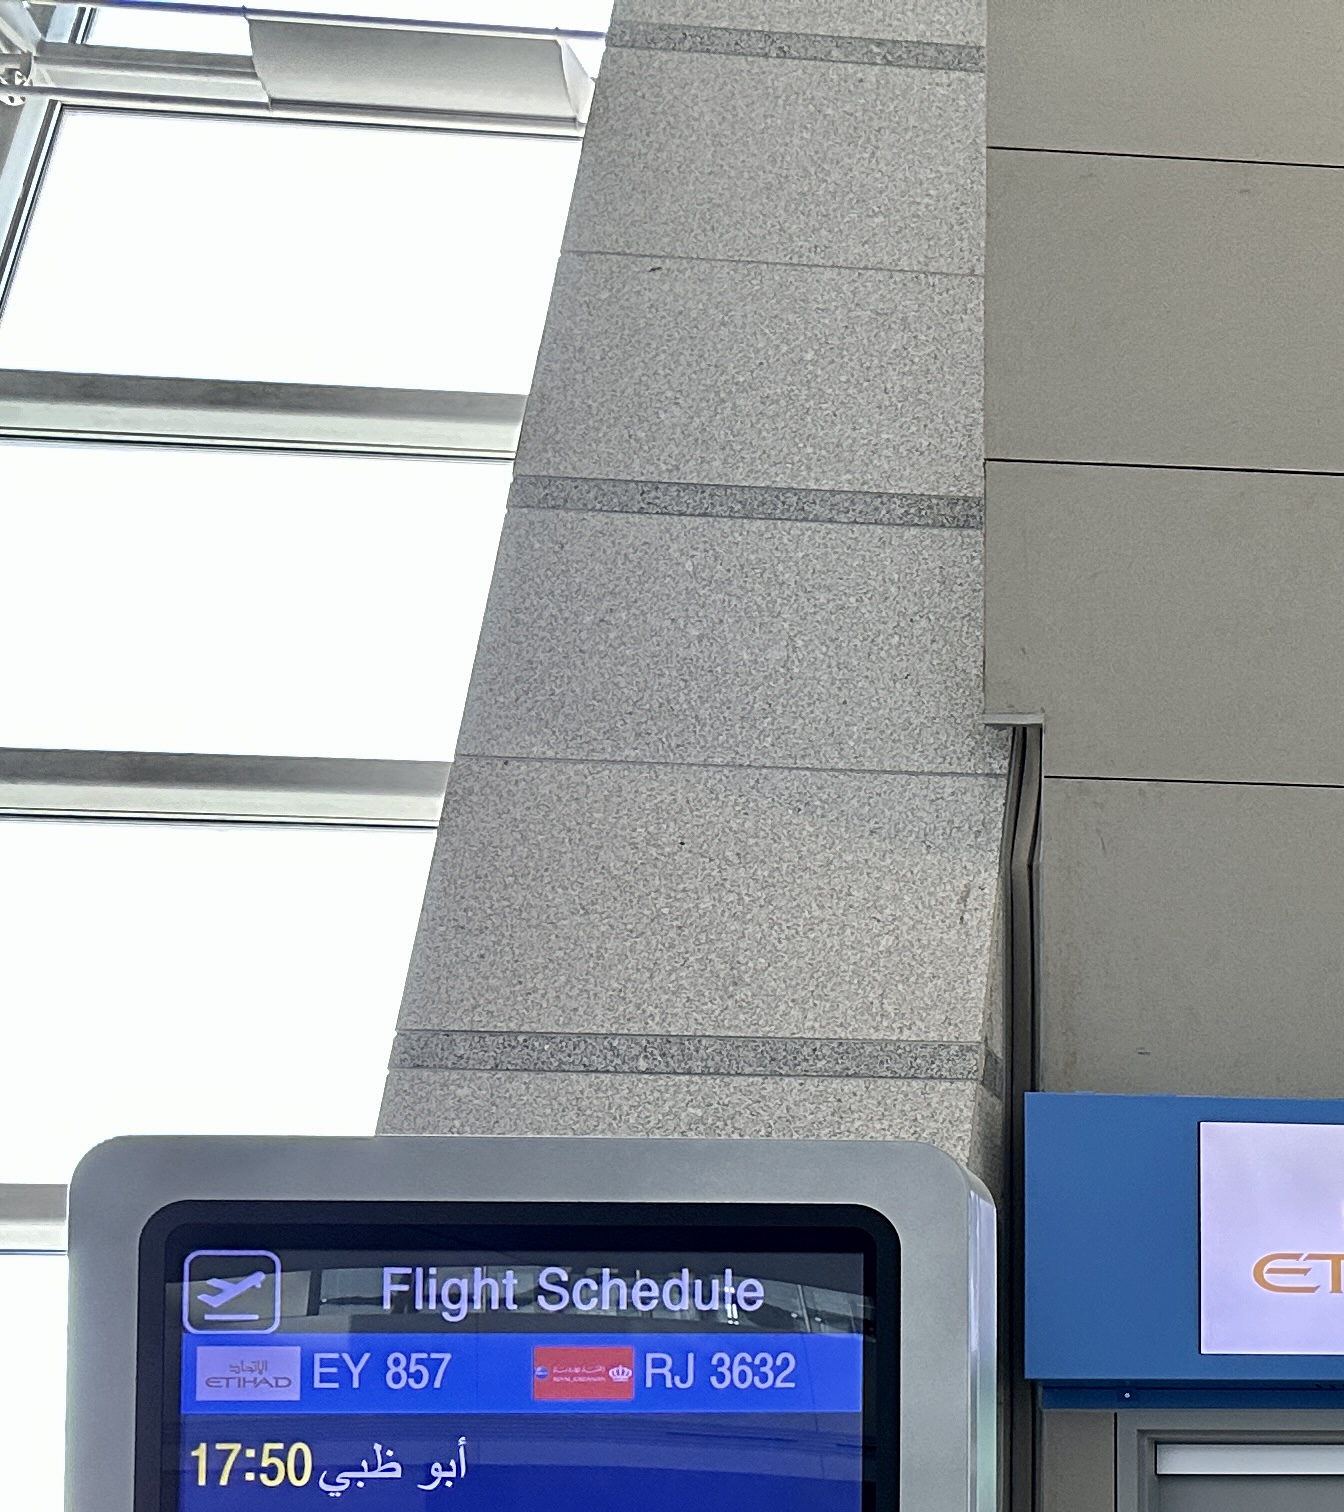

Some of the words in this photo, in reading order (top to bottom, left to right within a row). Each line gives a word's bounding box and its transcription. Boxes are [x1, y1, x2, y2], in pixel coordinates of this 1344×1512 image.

[382, 1266, 519, 1323] Flight
[537, 1266, 765, 1312] Schedule
[205, 1377, 292, 1389] ETIHAD
[313, 1352, 371, 1389] EY
[385, 1352, 452, 1390] 857
[644, 1352, 695, 1389] RJ
[710, 1352, 796, 1390] 3632
[191, 1442, 313, 1487] 17:50
[318, 1443, 402, 1497] ظبي
[417, 1436, 468, 1490] أبو
